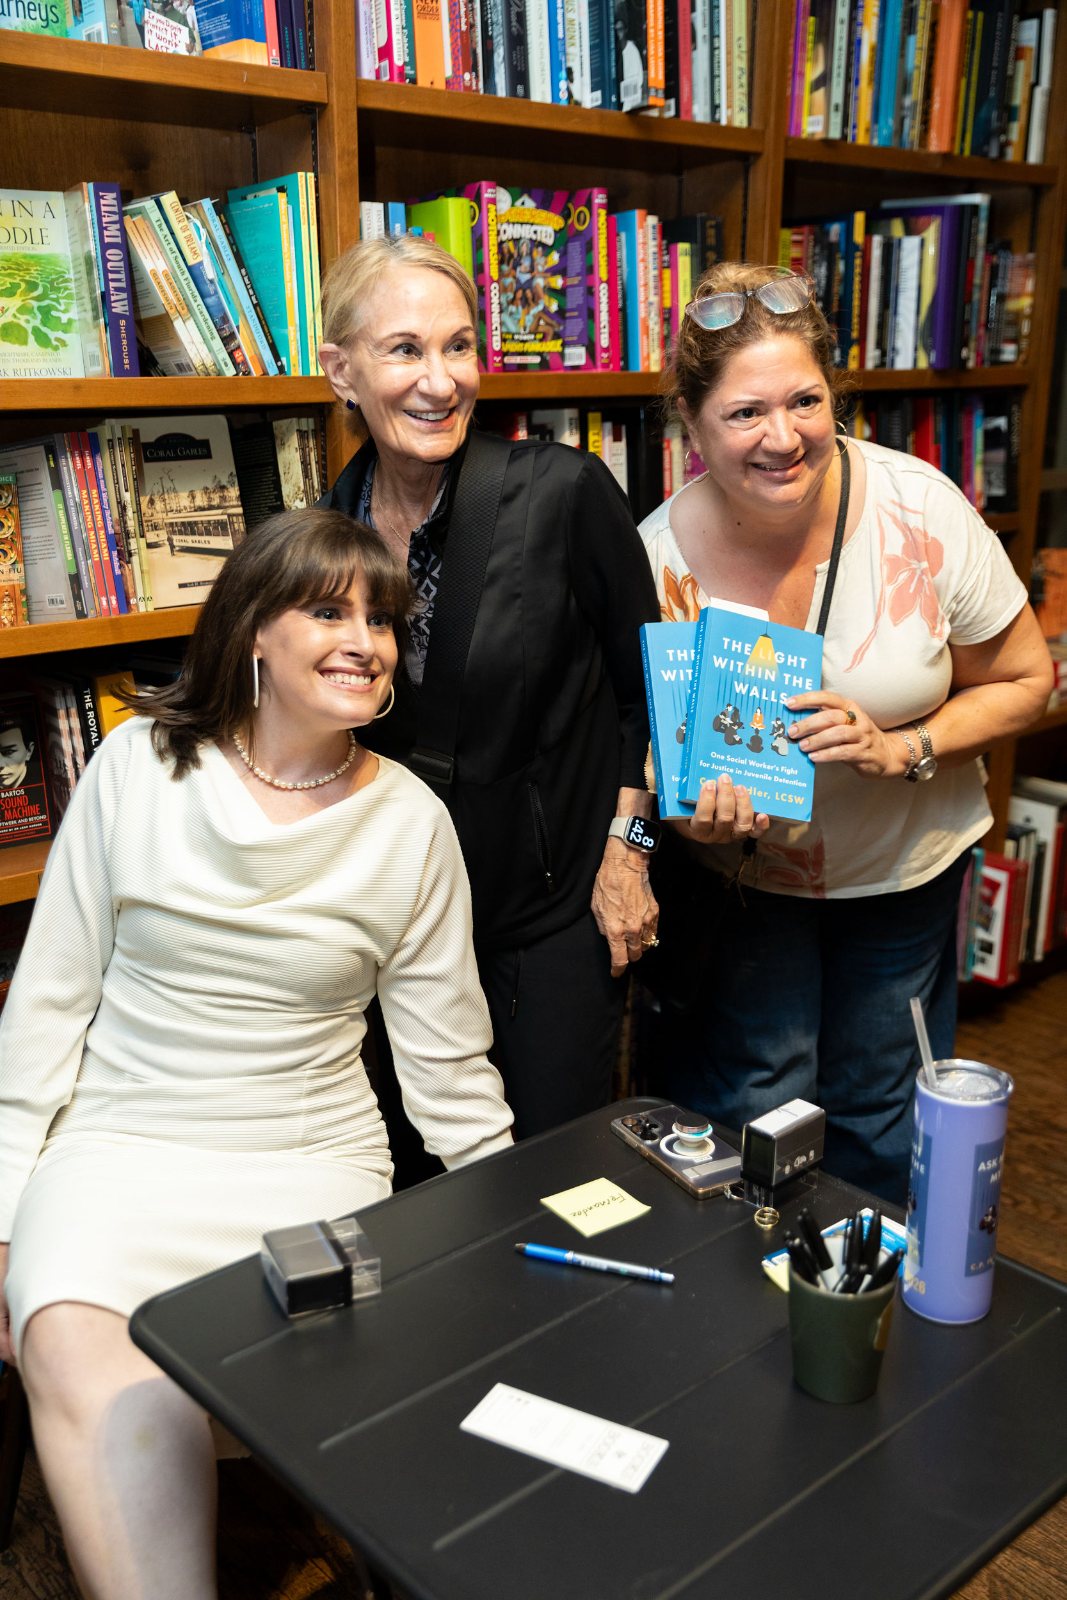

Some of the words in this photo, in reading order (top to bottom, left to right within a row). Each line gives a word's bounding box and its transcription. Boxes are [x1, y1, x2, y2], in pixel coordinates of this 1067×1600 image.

[12, 200, 34, 219] IN
[43, 200, 56, 219] A
[98, 191, 122, 244] MIAMI
[169, 200, 185, 225] CENTER
[180, 224, 189, 234] OF
[184, 233, 200, 260] DREAMS
[105, 250, 130, 316] OUTLAW
[152, 272, 174, 310] GLADESMEN
[155, 218, 163, 232] The
[163, 232, 171, 246] Art
[169, 245, 175, 255] of
[173, 255, 185, 277] South
[183, 276, 198, 303] Florida
[196, 303, 216, 342] Gardening
[490, 282, 501, 351] CONNECTED
[600, 282, 610, 348] CONNECTED
[119, 319, 130, 370] SHEROUSE
[13, 367, 72, 378] RUTKOWSKI
[147, 448, 175, 458] CORAL
[177, 446, 208, 456] GABLES
[81, 489, 92, 528] MAKING
[88, 530, 100, 561] MIAMI
[91, 489, 103, 528] MAKING
[100, 530, 109, 561] MIAMI
[723, 637, 752, 655] THE
[759, 648, 807, 669] LIGHT
[660, 669, 693, 681] WIT
[713, 655, 776, 682] WITHIN
[783, 673, 813, 690] THE
[83, 687, 94, 710] THE
[734, 681, 788, 704] WALLS
[87, 711, 100, 746] ROYAL
[699, 760, 710, 768] for
[710, 763, 734, 773] Justice
[743, 770, 772, 781] Juvenile
[773, 776, 807, 788] Detention
[710, 751, 725, 760] One
[726, 755, 747, 765] Social
[748, 760, 779, 772] Worker's
[780, 766, 798, 776] Fight
[0, 789, 25, 798] BARTOS
[0, 795, 29, 810] SOUND
[775, 792, 805, 805] LCSW
[4, 804, 40, 821] MACHINE
[642, 836, 654, 848] 8
[977, 1158, 999, 1173] ASK
[569, 1193, 626, 1217] Fernandez
